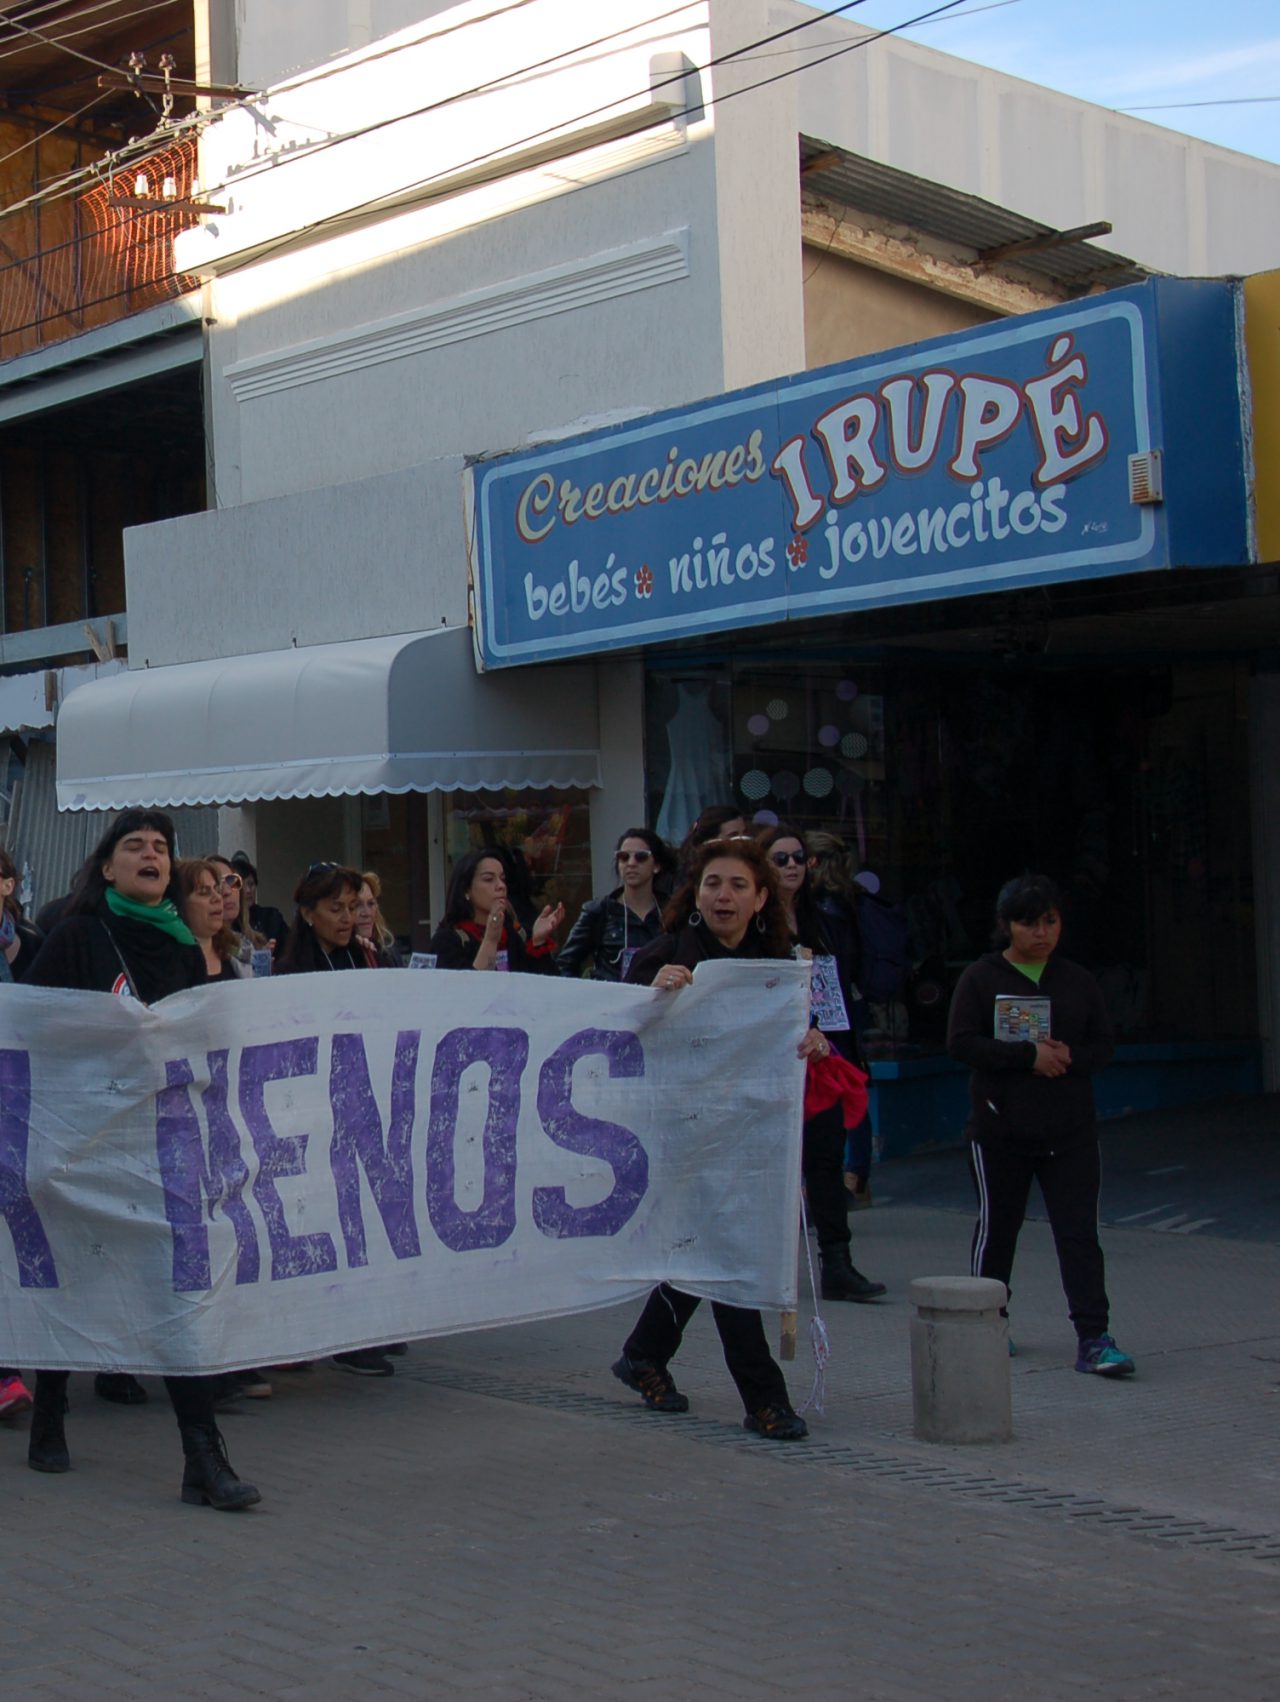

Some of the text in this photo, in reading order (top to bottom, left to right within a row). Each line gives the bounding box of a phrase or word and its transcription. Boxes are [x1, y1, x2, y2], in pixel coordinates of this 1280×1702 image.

[516, 429, 766, 544] Creaciones
[771, 332, 1109, 533] IRUPÉ
[524, 477, 1068, 621] bebés niños jovencitos
[155, 1026, 652, 1293] MENOS
